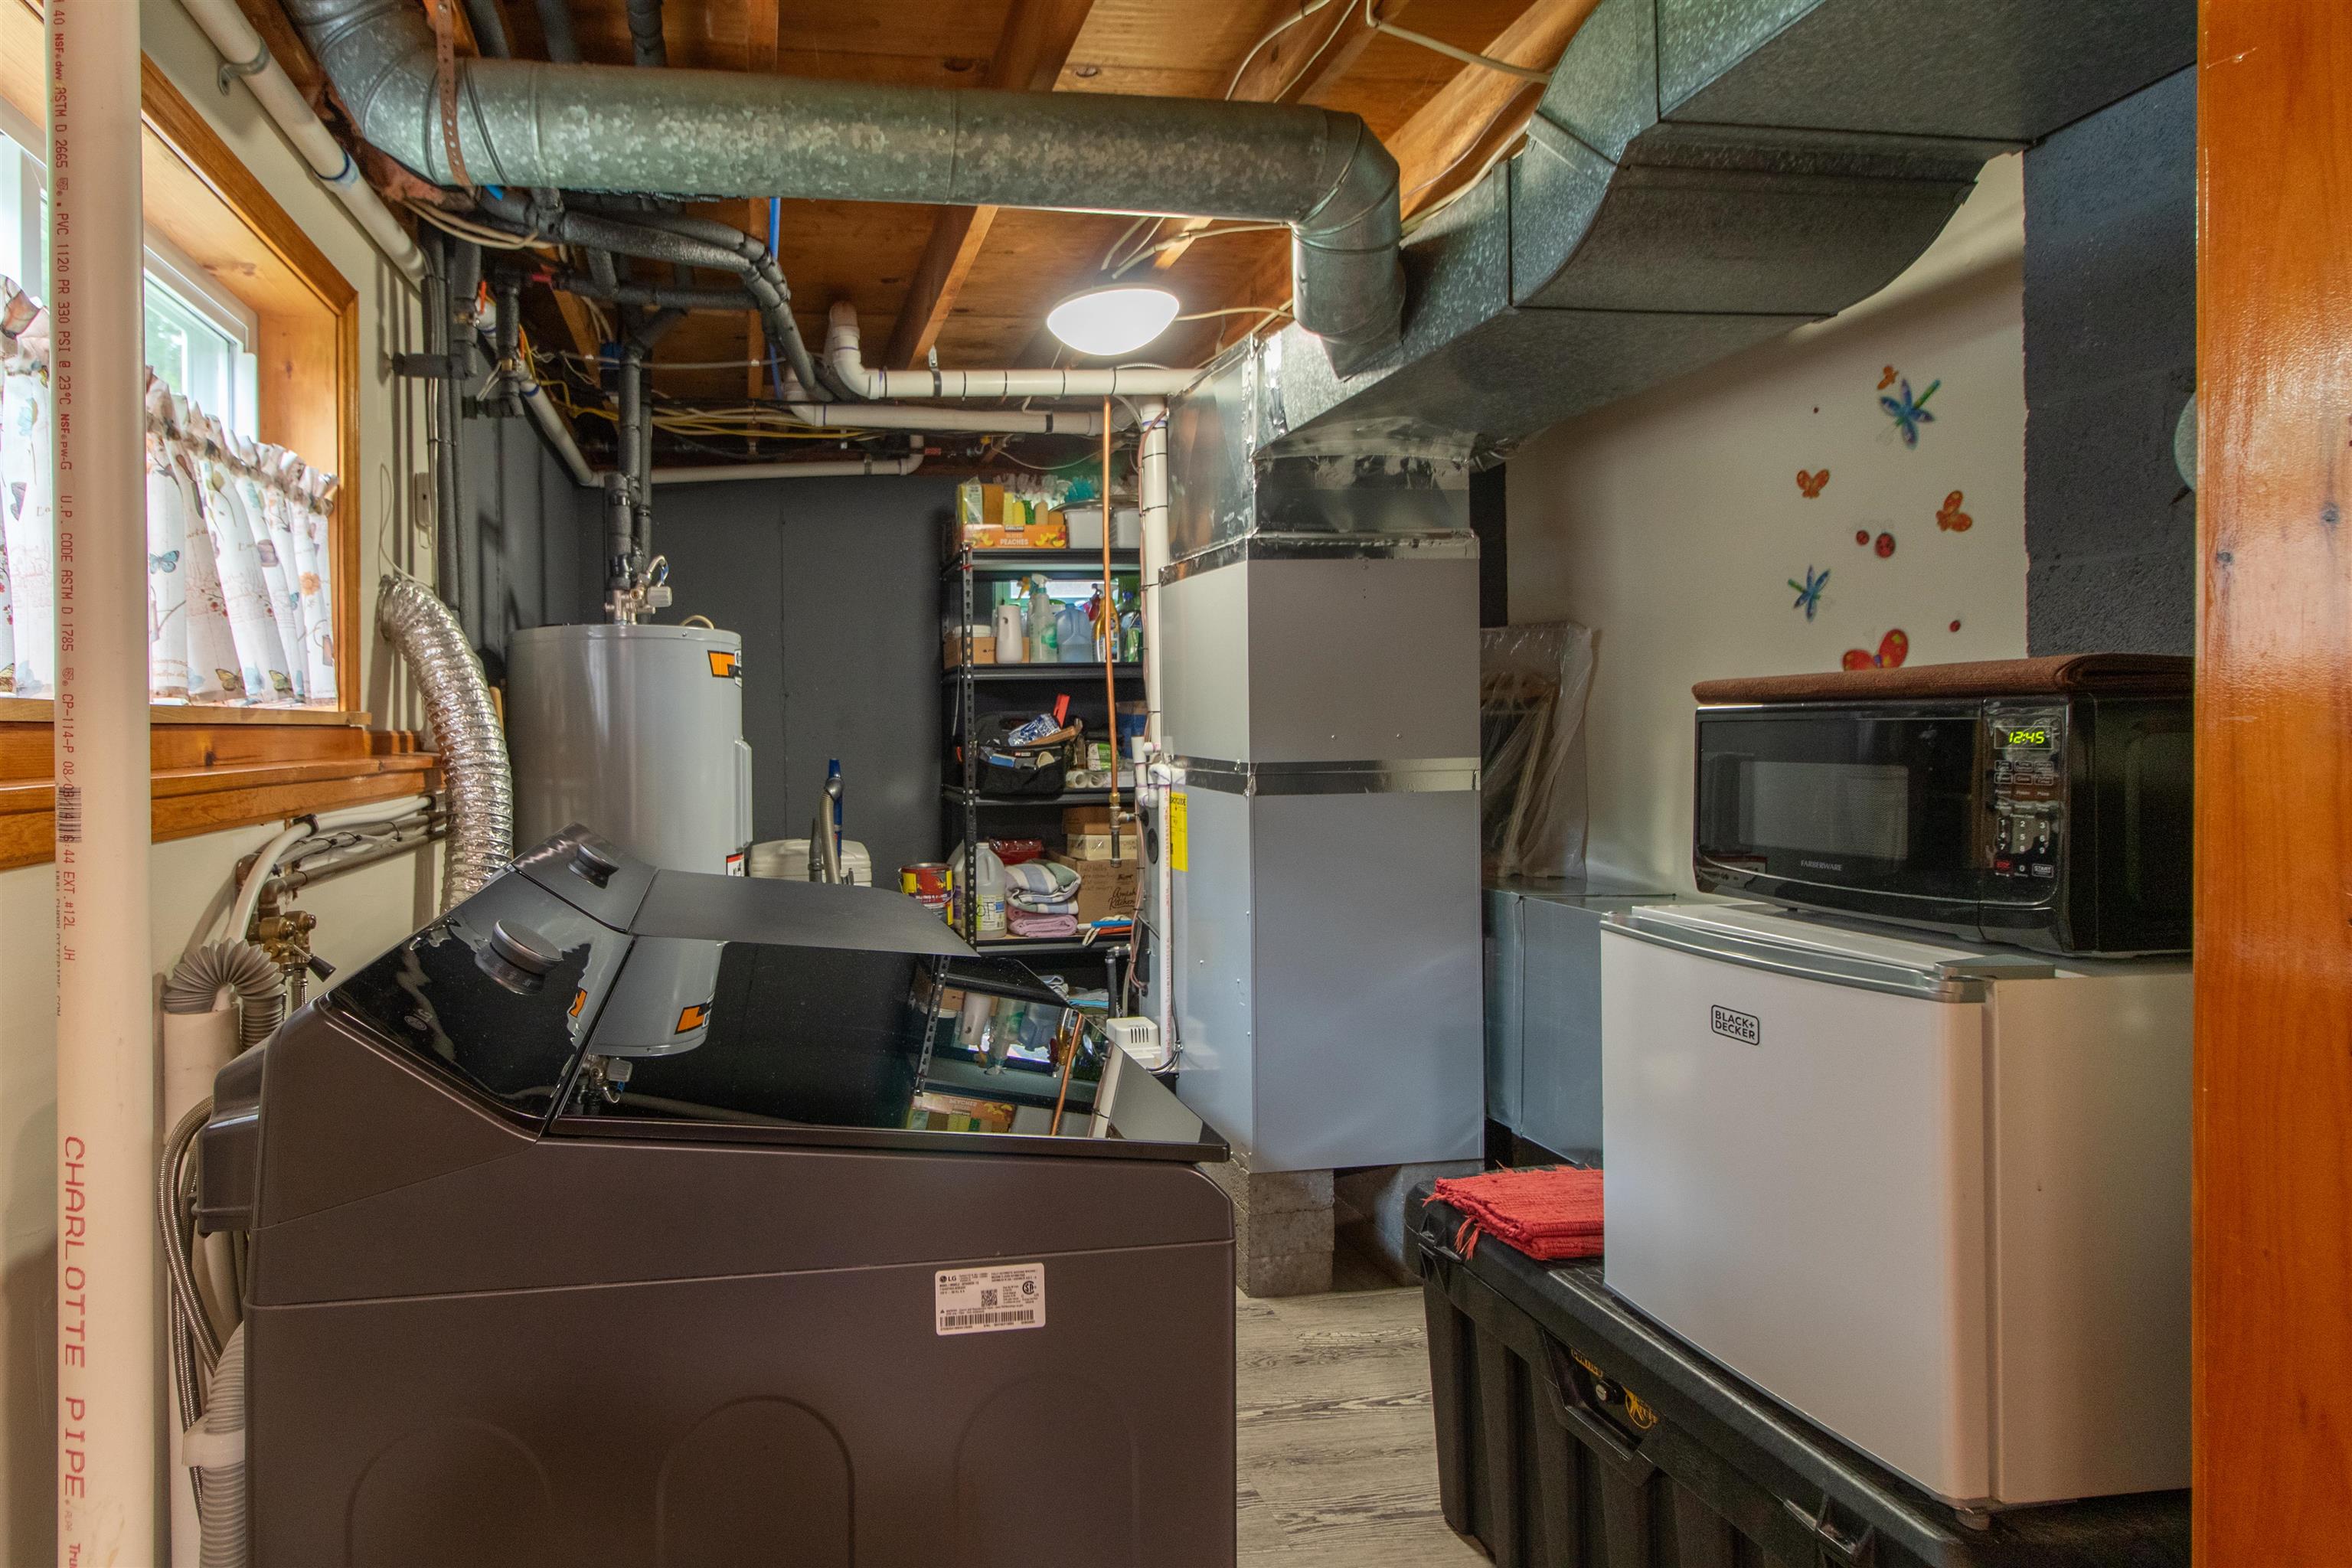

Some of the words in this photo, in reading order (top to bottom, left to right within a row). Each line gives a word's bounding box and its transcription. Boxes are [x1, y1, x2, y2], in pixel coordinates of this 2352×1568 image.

[53, 9, 65, 25] 40
[54, 87, 67, 117] ASTM
[54, 124, 67, 132] D
[55, 139, 68, 168] 2665
[57, 213, 69, 235] PVC
[57, 244, 70, 272] 1120
[57, 279, 70, 294] PR
[58, 302, 70, 324] 330
[58, 331, 70, 351] PSI
[59, 375, 72, 404] 23°C
[60, 495, 73, 524] U.P.
[61, 533, 74, 563] CODE
[61, 570, 74, 599] ASTM
[61, 623, 74, 652] 1785
[62, 694, 74, 753] CP-114-P
[2008, 730, 2045, 744] 12:45
[1800, 859, 1843, 871] FARBERWARE
[64, 945, 75, 961] JH
[1715, 1010, 1755, 1028] BLACK+
[1715, 1020, 1756, 1040] DECKER
[65, 1136, 86, 1368] CHARLOTTE
[65, 1396, 86, 1499] PIPE
